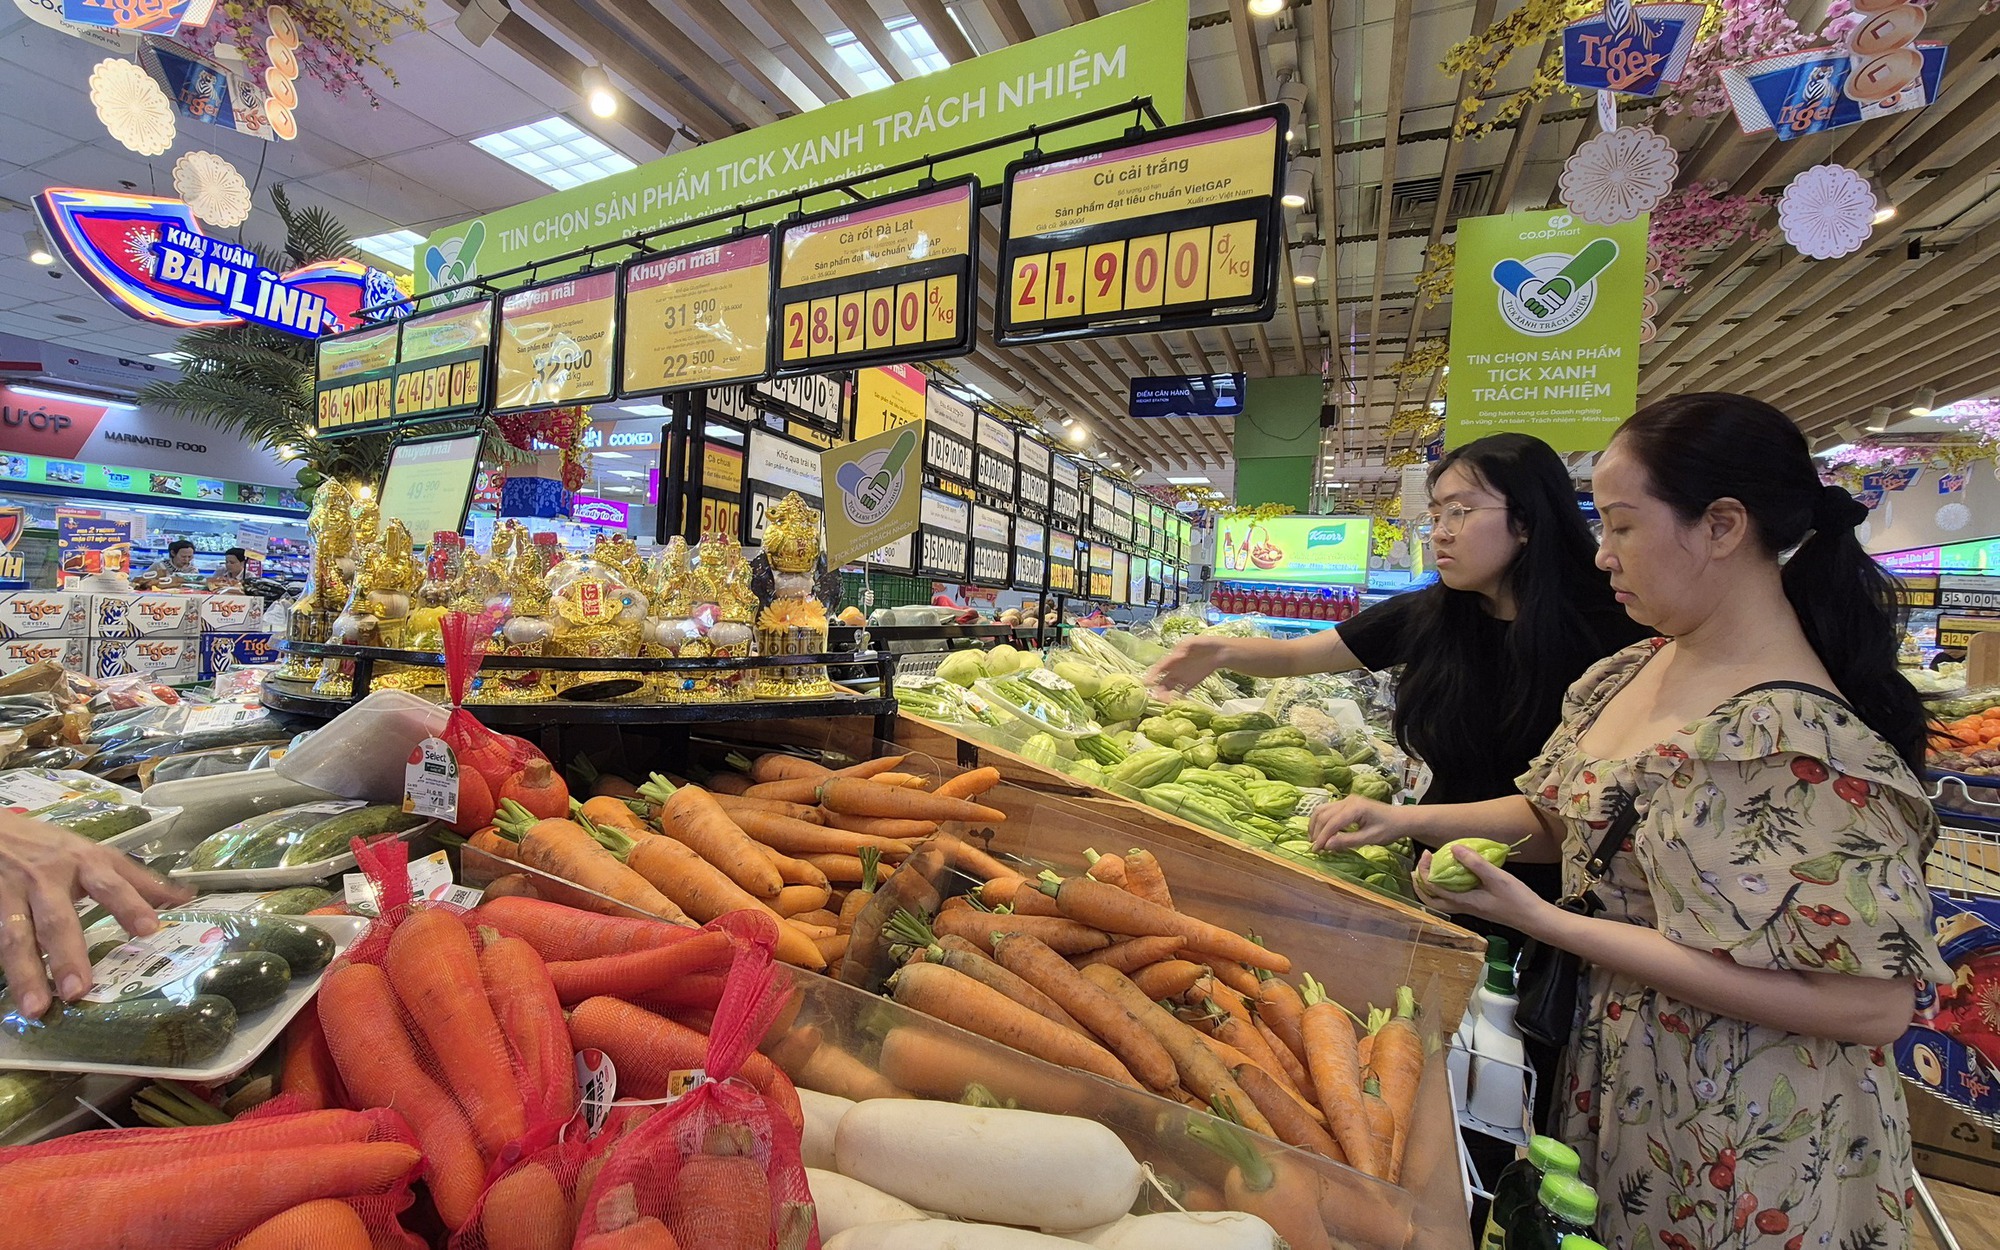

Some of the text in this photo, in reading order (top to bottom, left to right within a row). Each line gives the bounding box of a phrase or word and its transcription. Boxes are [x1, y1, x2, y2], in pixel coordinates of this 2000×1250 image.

[1578, 34, 1660, 84] Tiger
[499, 45, 1128, 253] TIN CHỌN SẢN PHẨM TICK XANH TRÁCH NHIỆM
[1093, 156, 1189, 187] Củ cải trắng
[1055, 178, 1232, 218] Sản phẩm đạt tiêu chuẩn VietGAP
[839, 218, 914, 245] Cà rốt Đà Lạt
[211, 243, 255, 269] XUÂN
[814, 260, 828, 271] Sản
[829, 255, 850, 269] phẩm
[851, 253, 864, 264] đạt
[881, 243, 906, 258] chuẩn
[1018, 241, 1199, 306] 21.900
[160, 246, 324, 334] BẢN LĨNH
[664, 303, 686, 330] 31
[789, 292, 919, 349] 28.900
[1505, 300, 1518, 317] TICK
[1515, 316, 1537, 329] XANH
[1539, 316, 1569, 329] TRÁCH
[663, 349, 715, 379] 22 500
[1466, 343, 1621, 365] TIN CHỌN SẢN PHẨM
[1487, 364, 1597, 383] TICK XANH
[396, 369, 463, 405] 24.500
[1136, 388, 1190, 398] ĐIỂM CÂN HÀNG
[1472, 381, 1611, 402] TRÁCH NHIỆM
[320, 386, 377, 420] 36.900
[3, 405, 72, 434] ƯỚP
[104, 430, 207, 454] MARINATED FOOD
[609, 432, 653, 447] COOKED
[707, 454, 731, 468] Cà chua
[776, 449, 788, 461] Khổ
[789, 455, 800, 464] qua
[575, 509, 599, 520] Ready
[601, 511, 609, 519] to
[1309, 531, 1343, 541] Knorr
[10, 600, 64, 621] Tiger
[209, 600, 246, 618] Tiger
[1943, 593, 1991, 605] 55.000
[138, 602, 182, 621] Tiger
[6, 643, 61, 664] Tiger
[135, 642, 179, 661] Tiger
[242, 638, 270, 656] Tige
[425, 750, 447, 763] Select
[1957, 1070, 1990, 1099] Tiger
